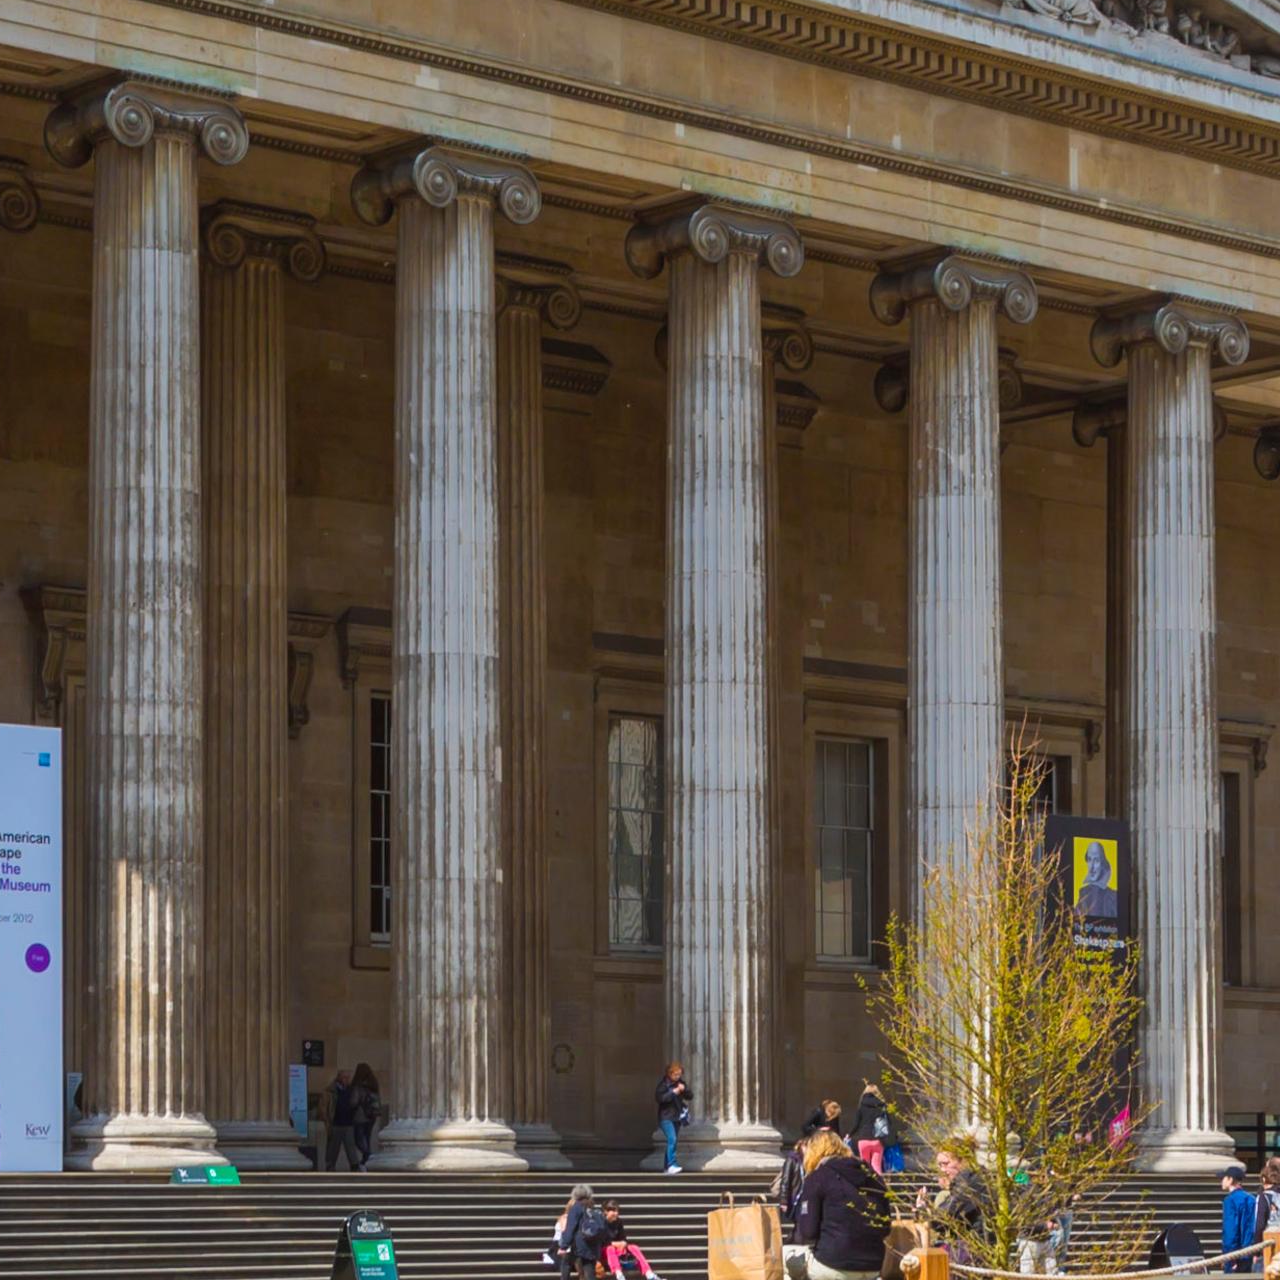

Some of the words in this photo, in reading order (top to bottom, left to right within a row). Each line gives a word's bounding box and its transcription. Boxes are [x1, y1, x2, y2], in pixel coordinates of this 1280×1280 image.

[2, 863, 21, 875] the
[0, 878, 51, 892] Museum
[13, 914, 33, 923] 2012
[25, 1123, 51, 1136] Kew
